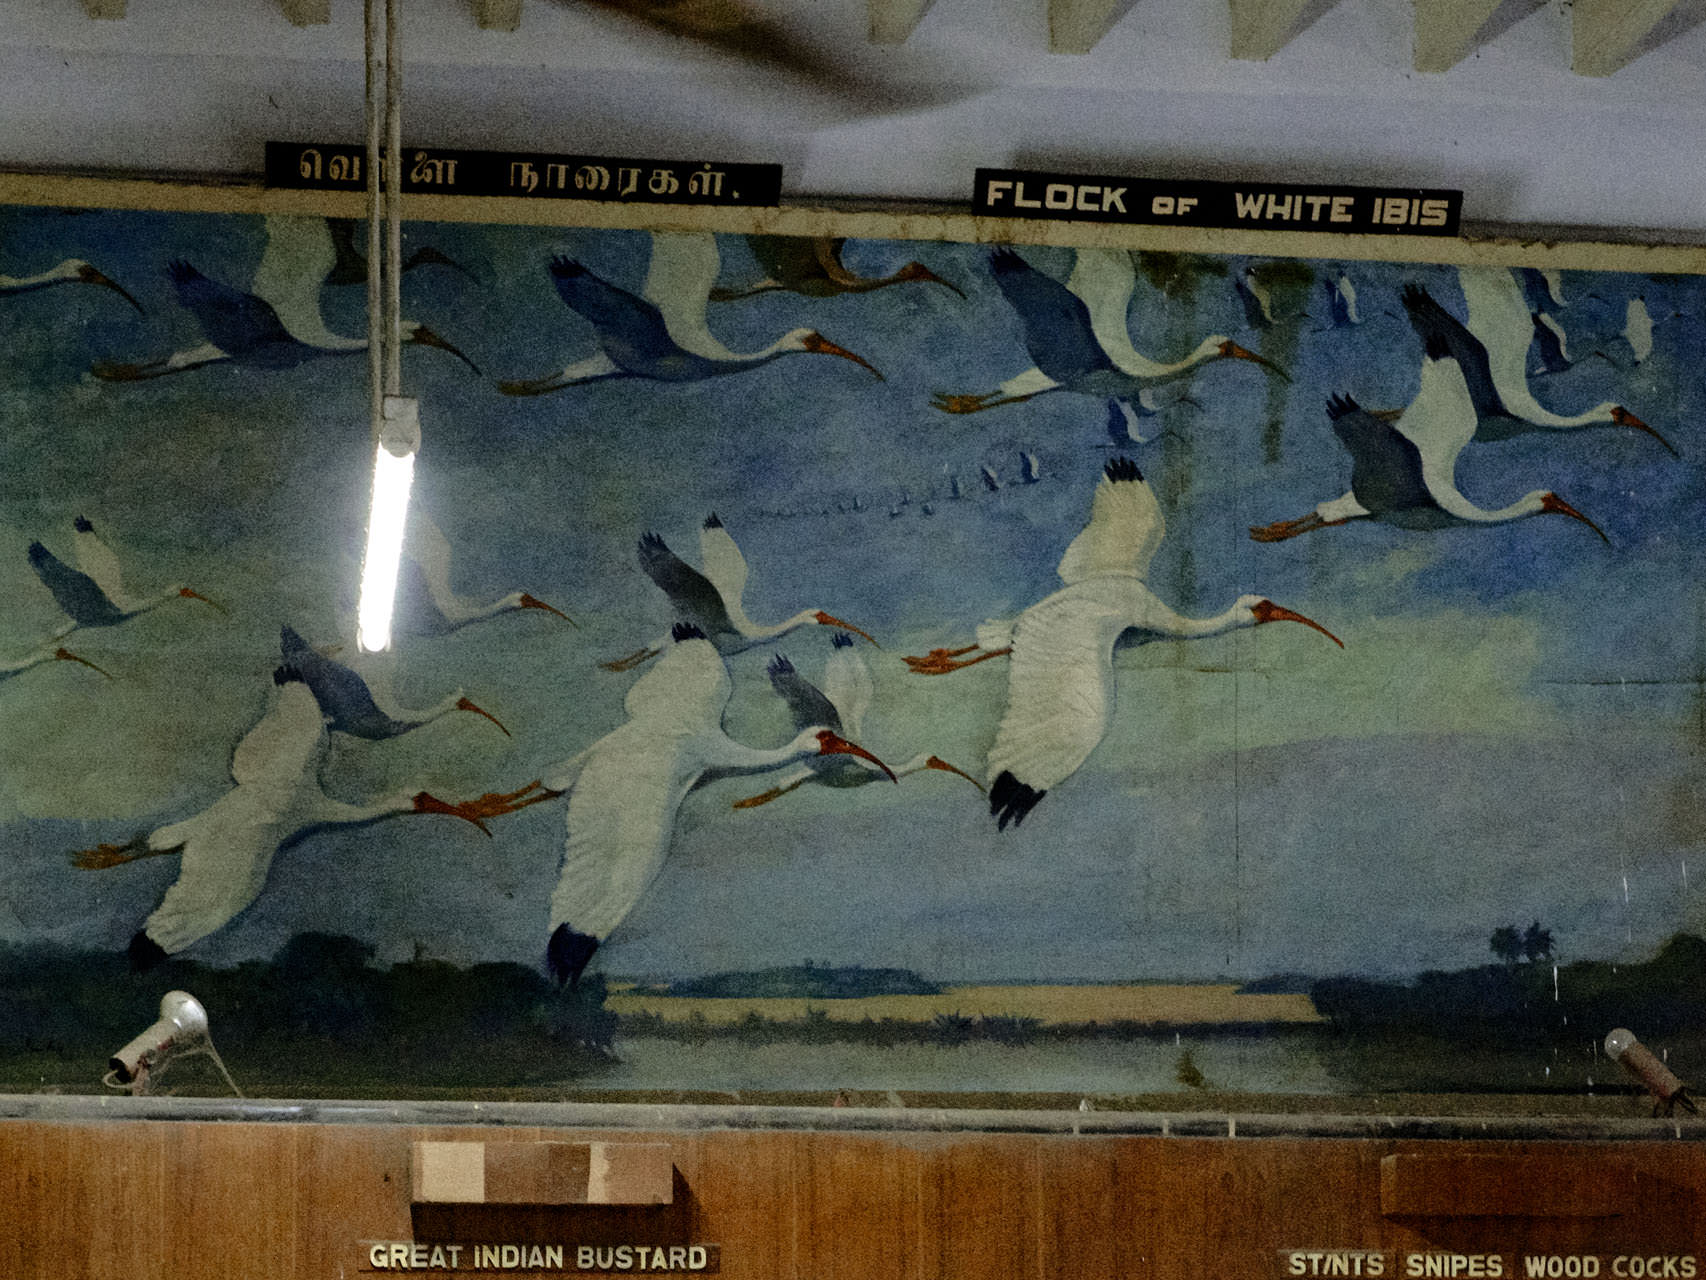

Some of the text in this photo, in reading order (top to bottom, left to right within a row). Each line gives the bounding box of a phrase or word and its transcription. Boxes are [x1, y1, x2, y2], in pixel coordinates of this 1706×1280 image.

[986, 180, 1450, 227] FLOCK OF WHITE IBIS
[369, 1243, 708, 1271] GREAT INDIAN BUSTARD
[1288, 1252, 1697, 1280] STINTS SNIPES WOOD COCKS
